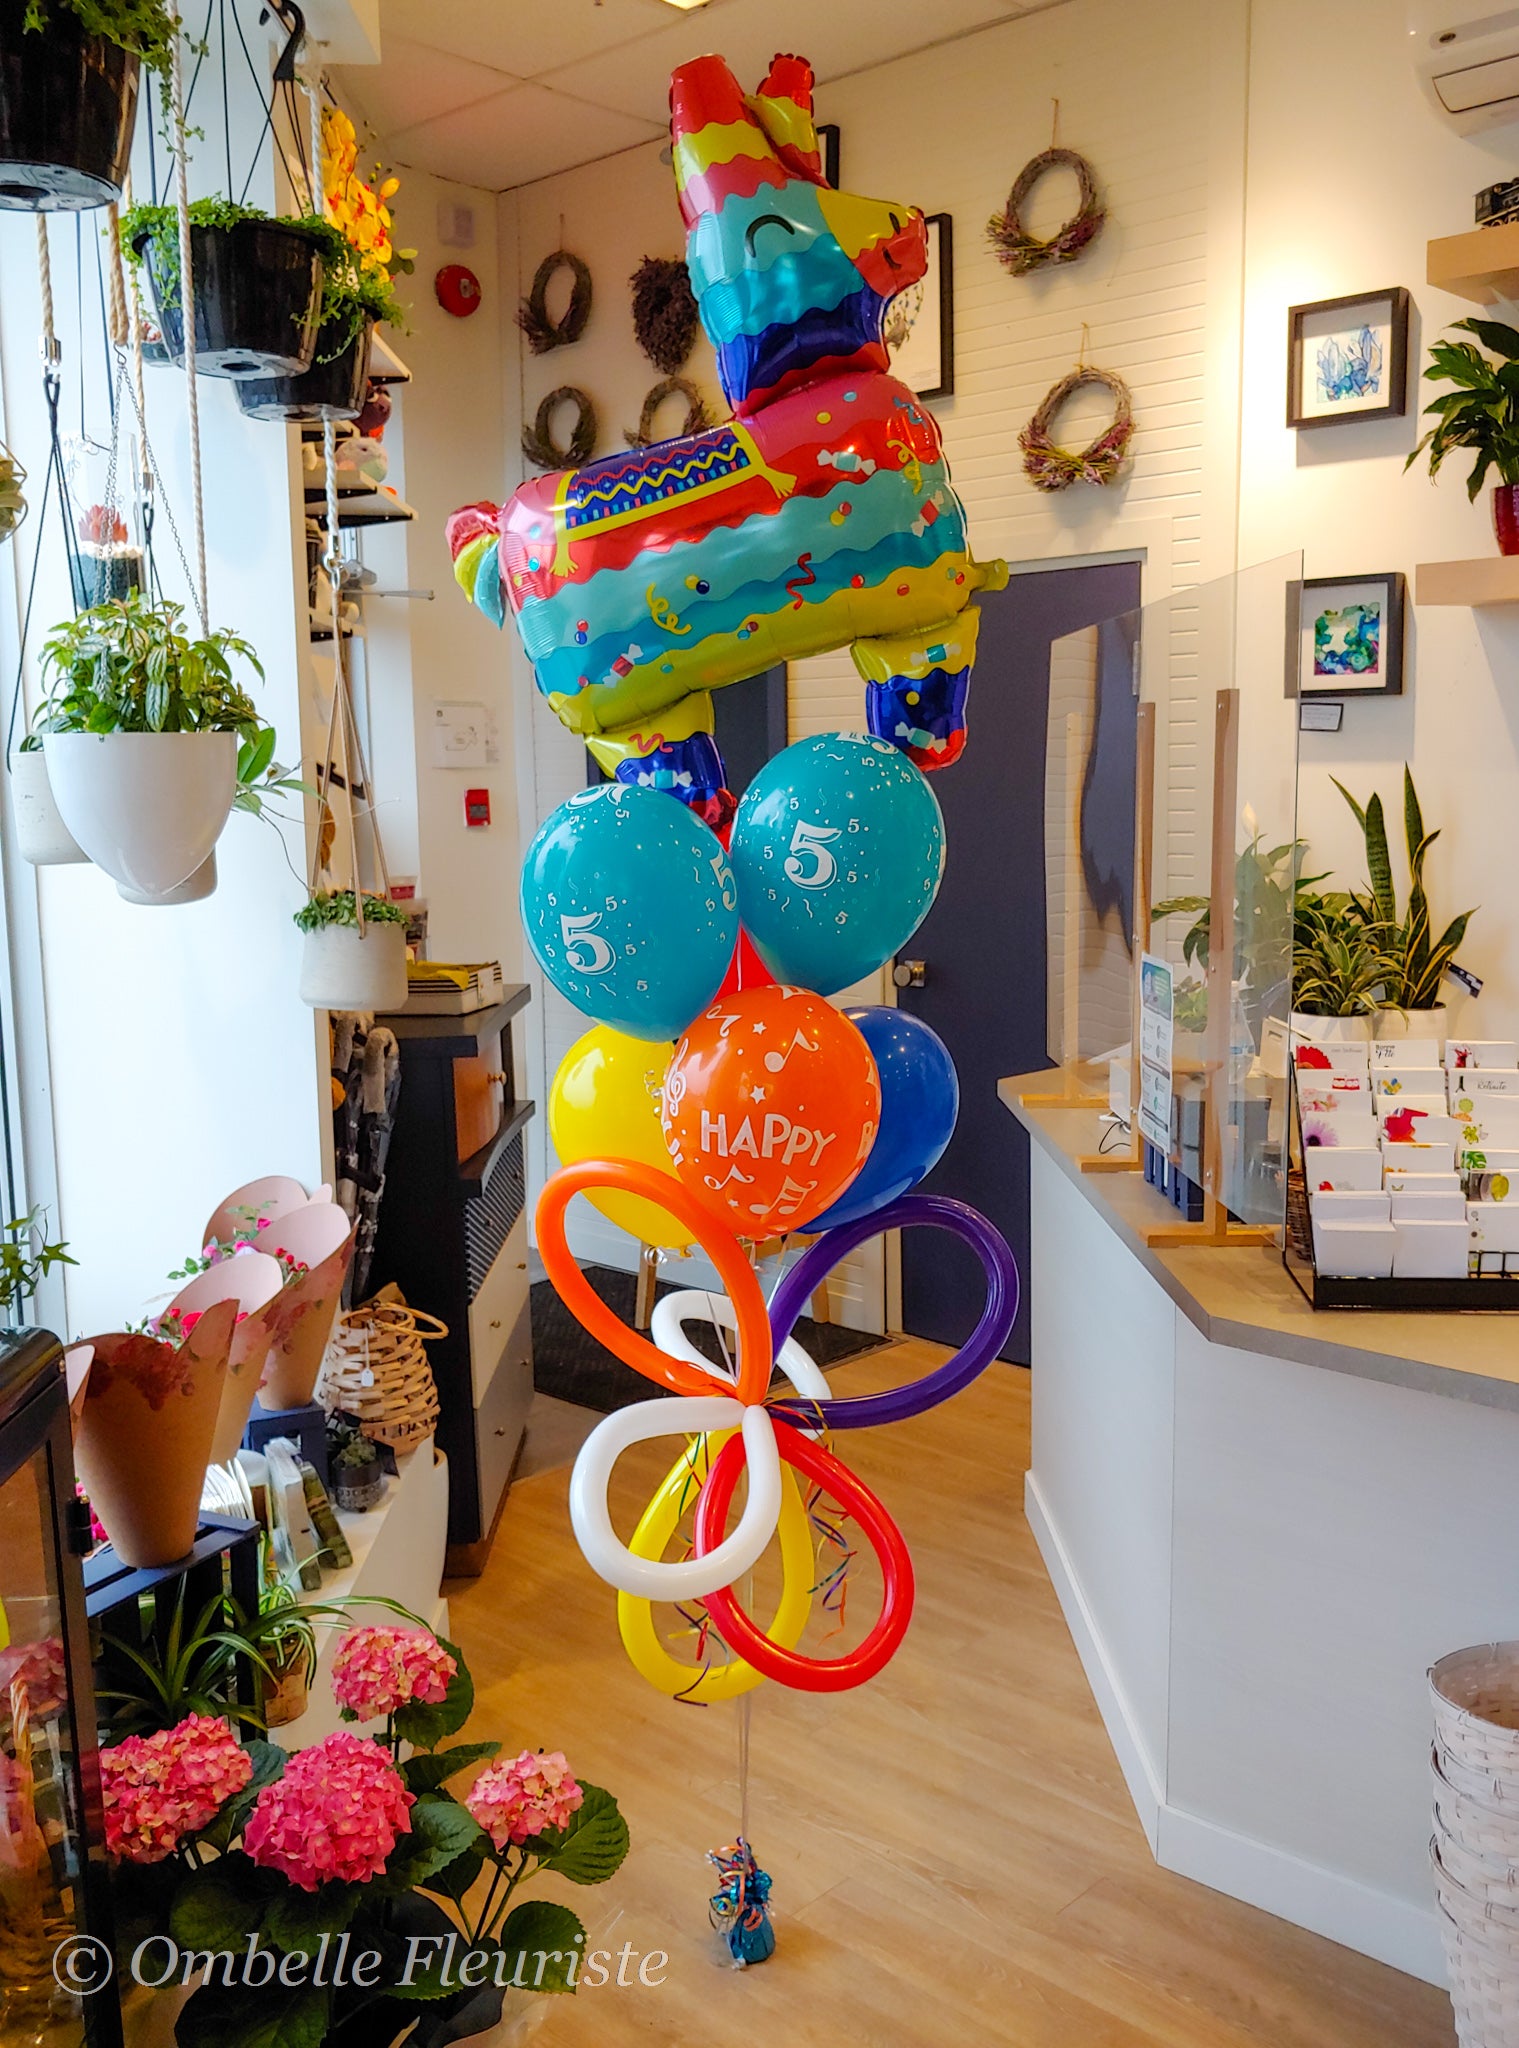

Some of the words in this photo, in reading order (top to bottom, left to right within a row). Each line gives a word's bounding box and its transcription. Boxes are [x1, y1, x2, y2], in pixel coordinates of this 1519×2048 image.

[813, 743, 825, 752] 5
[862, 757, 875, 767] 5
[902, 771, 912, 783] 5
[751, 788, 761, 801] 5
[790, 797, 799, 811] 5
[615, 808, 630, 819] 5
[847, 819, 860, 833] 5
[933, 825, 939, 838] 5
[691, 846, 702, 858] 5
[764, 846, 773, 860] 5
[784, 819, 843, 890] 5
[709, 847, 737, 911] 5
[847, 871, 858, 883] 5
[924, 878, 931, 891] 5
[548, 893, 557, 907] 5
[768, 889, 777, 901] 5
[605, 896, 618, 911] 5
[705, 898, 716, 912] 5
[835, 911, 848, 925] 5
[560, 912, 616, 975] 5
[625, 944, 637, 956] 5
[544, 944, 556, 958] 5
[636, 980, 648, 991] 5
[701, 1110, 836, 1166] HAPPY
